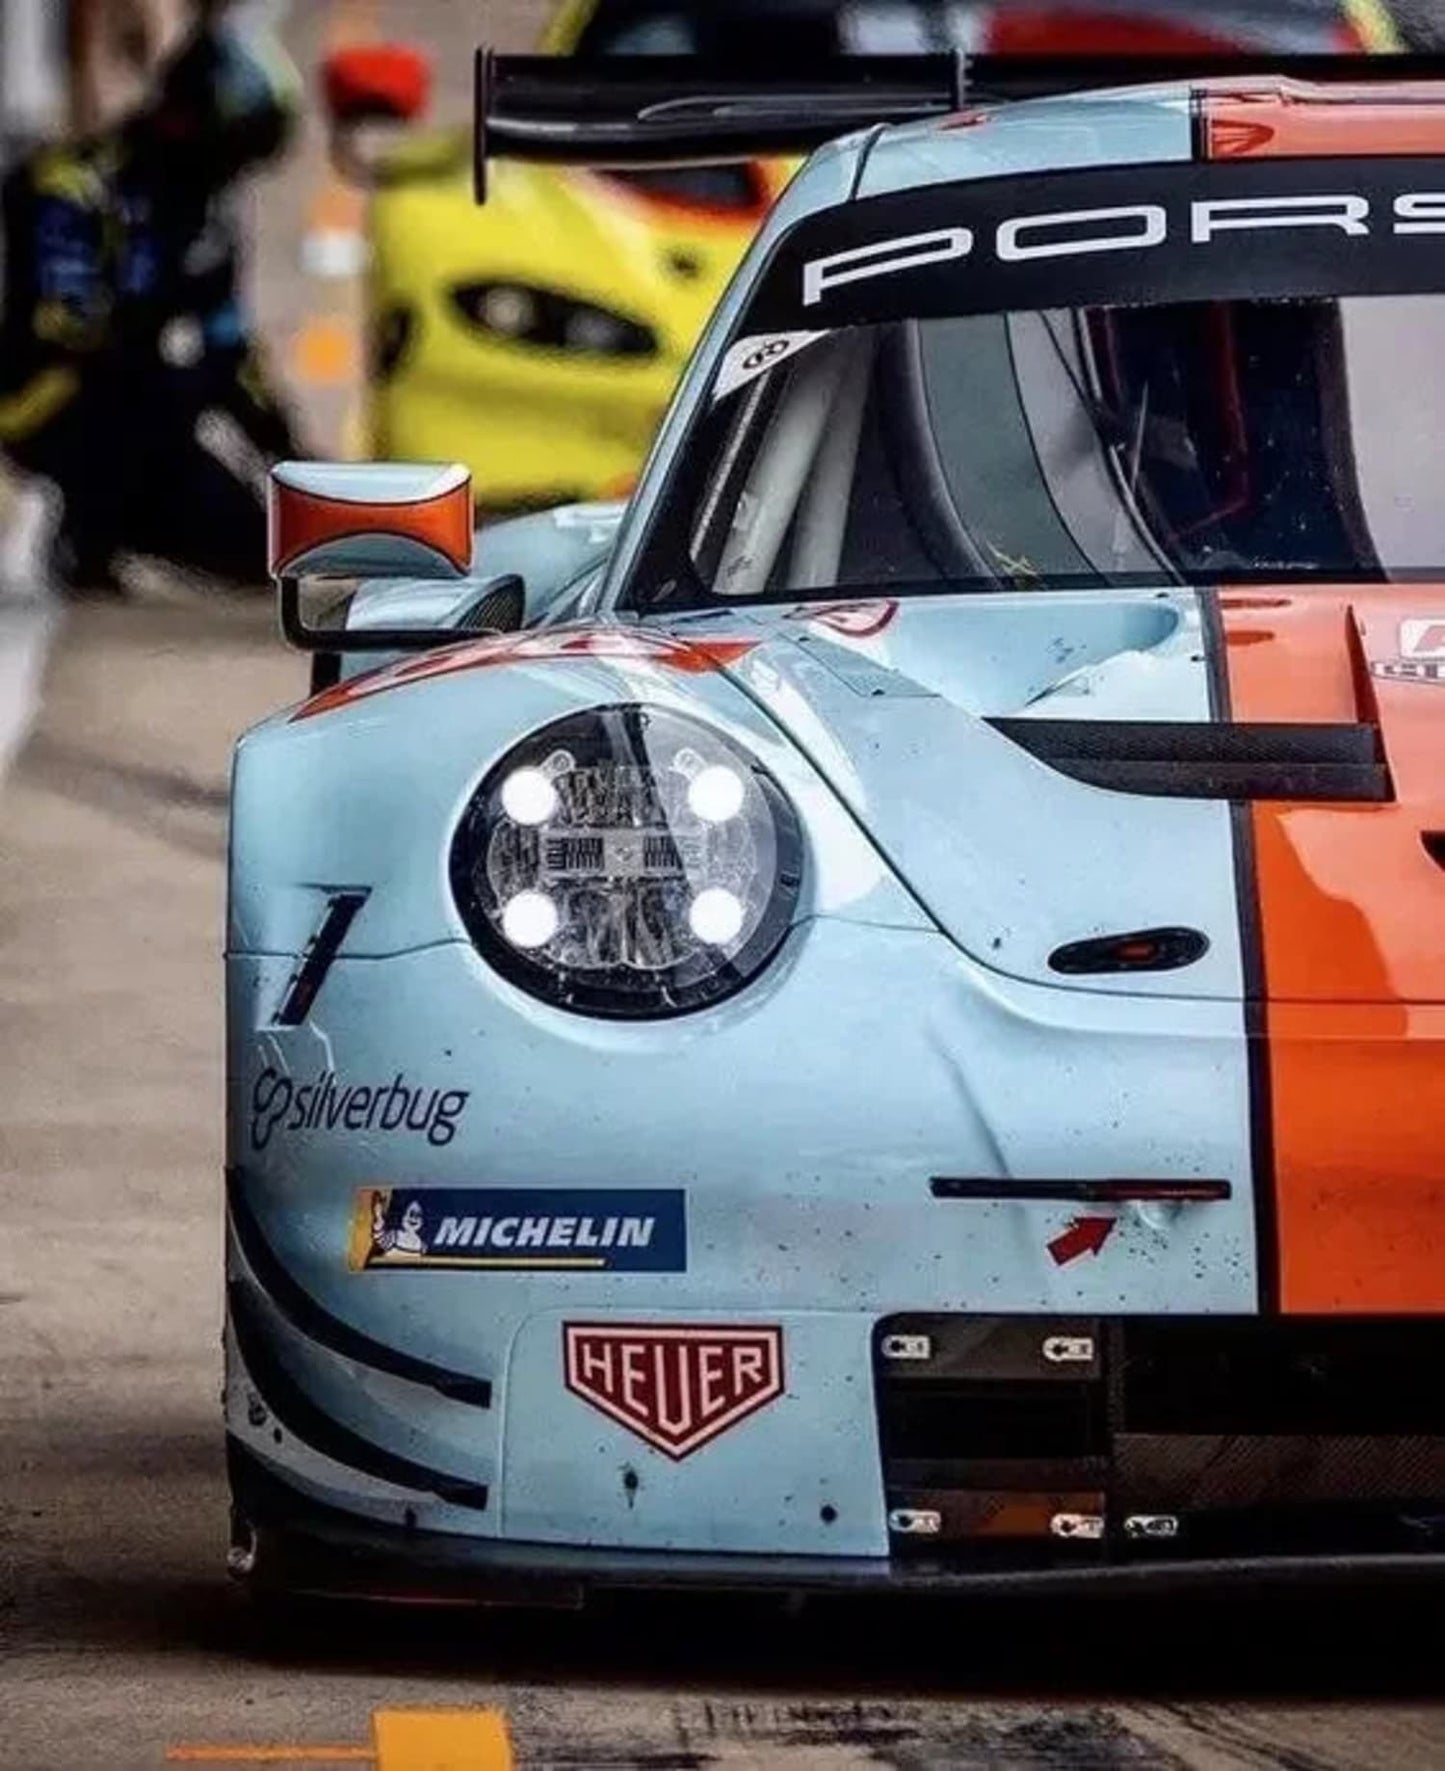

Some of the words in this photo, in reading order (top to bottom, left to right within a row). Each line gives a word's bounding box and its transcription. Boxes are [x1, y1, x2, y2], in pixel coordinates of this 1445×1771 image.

[287, 1070, 470, 1146] silverbug
[433, 1216, 656, 1248] MICHELIN
[582, 1342, 763, 1436] HEUER
